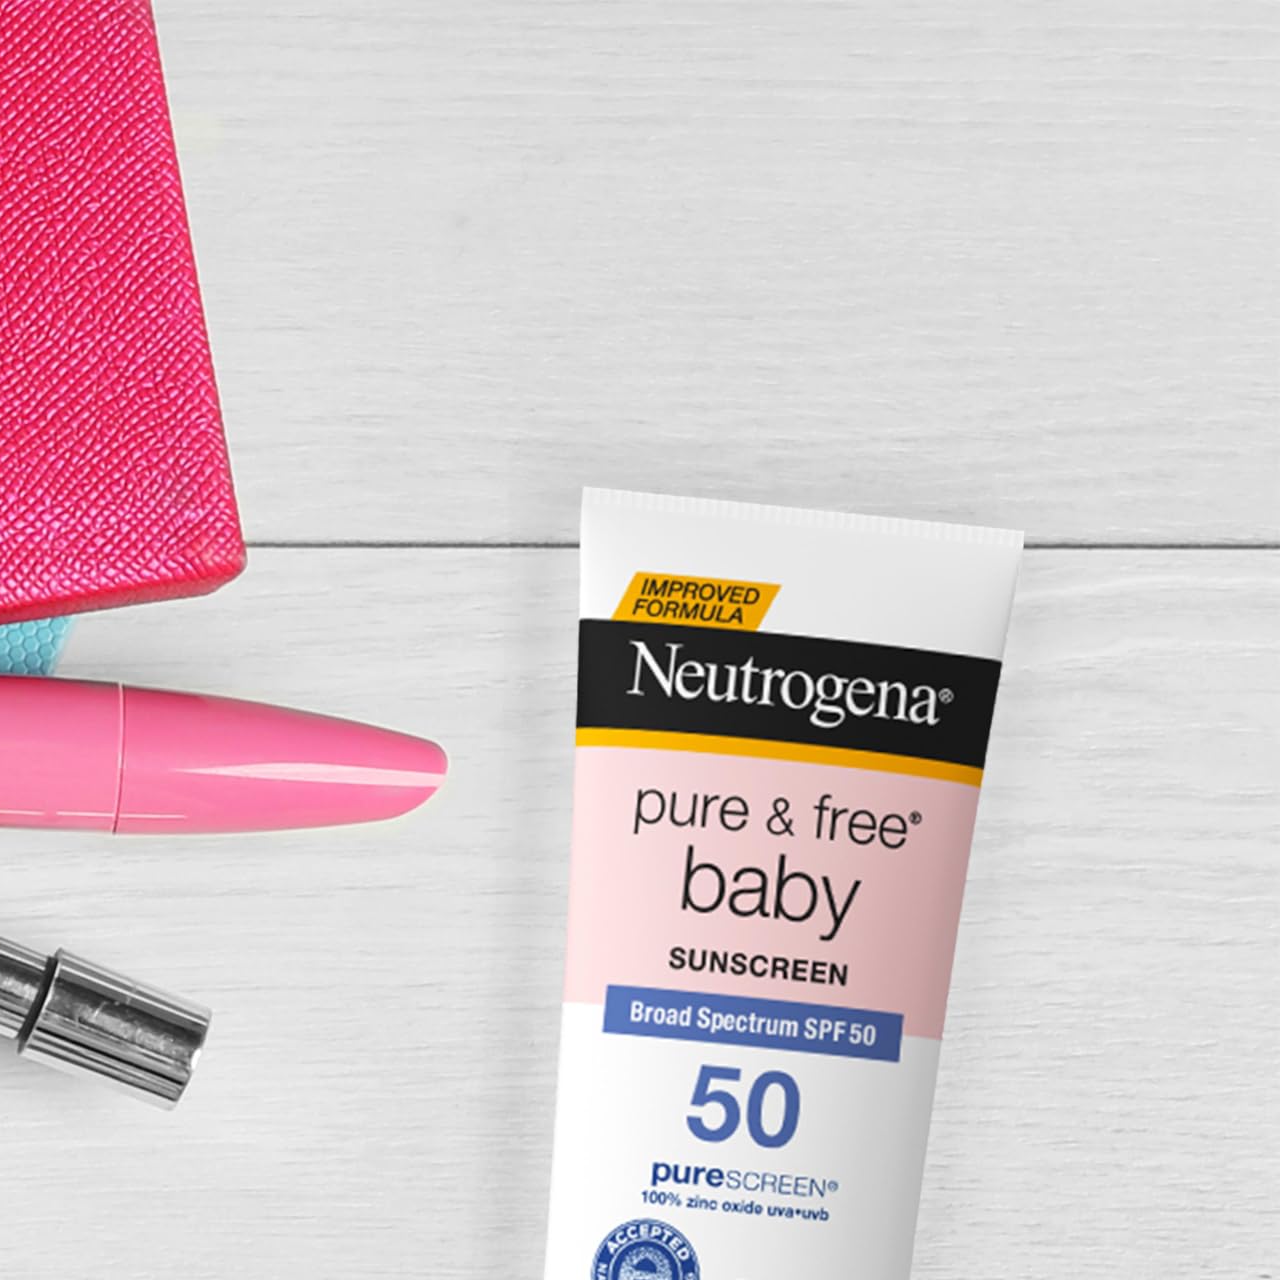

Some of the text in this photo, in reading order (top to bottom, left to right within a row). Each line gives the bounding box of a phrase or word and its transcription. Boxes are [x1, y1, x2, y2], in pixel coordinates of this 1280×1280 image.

[632, 599, 744, 625] FORMULA
[640, 577, 760, 606] IMPROVED
[633, 788, 750, 835] pure
[766, 797, 795, 837] &
[681, 844, 862, 942] baby
[668, 946, 849, 987] SUNSCREEN
[630, 1000, 877, 1046] Broad Spectrum SPF 50
[686, 1064, 801, 1149] 50
[641, 1190, 682, 1207] 100%
[687, 1195, 718, 1211] zinc
[722, 1199, 763, 1216] oxide
[607, 1224, 691, 1261] ACCEPTED
